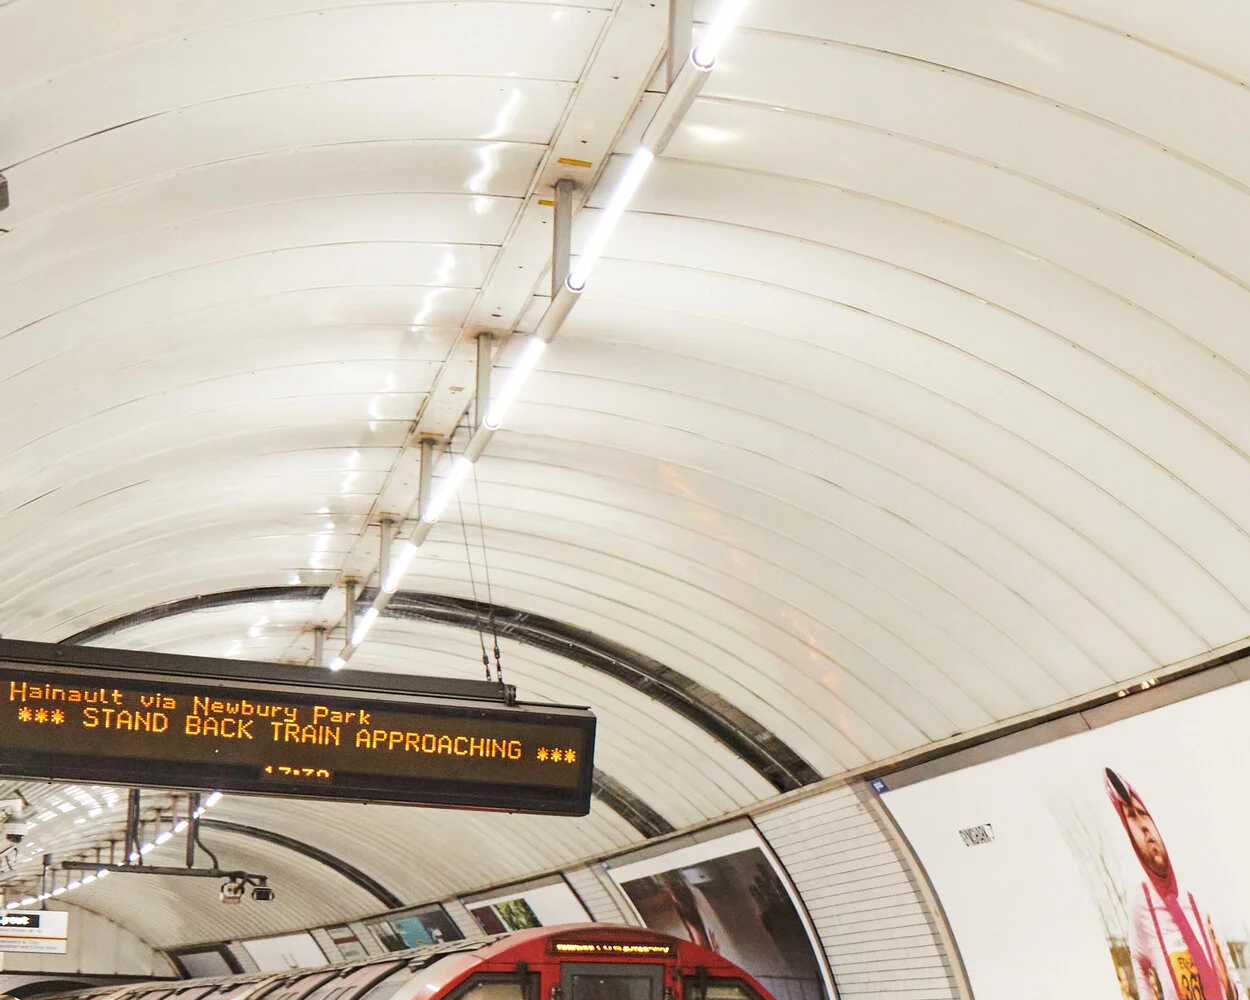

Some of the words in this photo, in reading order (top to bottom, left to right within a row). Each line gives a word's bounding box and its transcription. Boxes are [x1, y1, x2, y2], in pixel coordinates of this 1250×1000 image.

[10, 681, 123, 705] Hainault
[140, 693, 176, 710] via
[193, 696, 297, 722] Newbury
[313, 706, 371, 725] Park
[83, 707, 169, 733] STAND
[185, 714, 254, 740] BACK
[271, 721, 341, 746] TRAIN
[356, 728, 522, 761] APPROACHING
